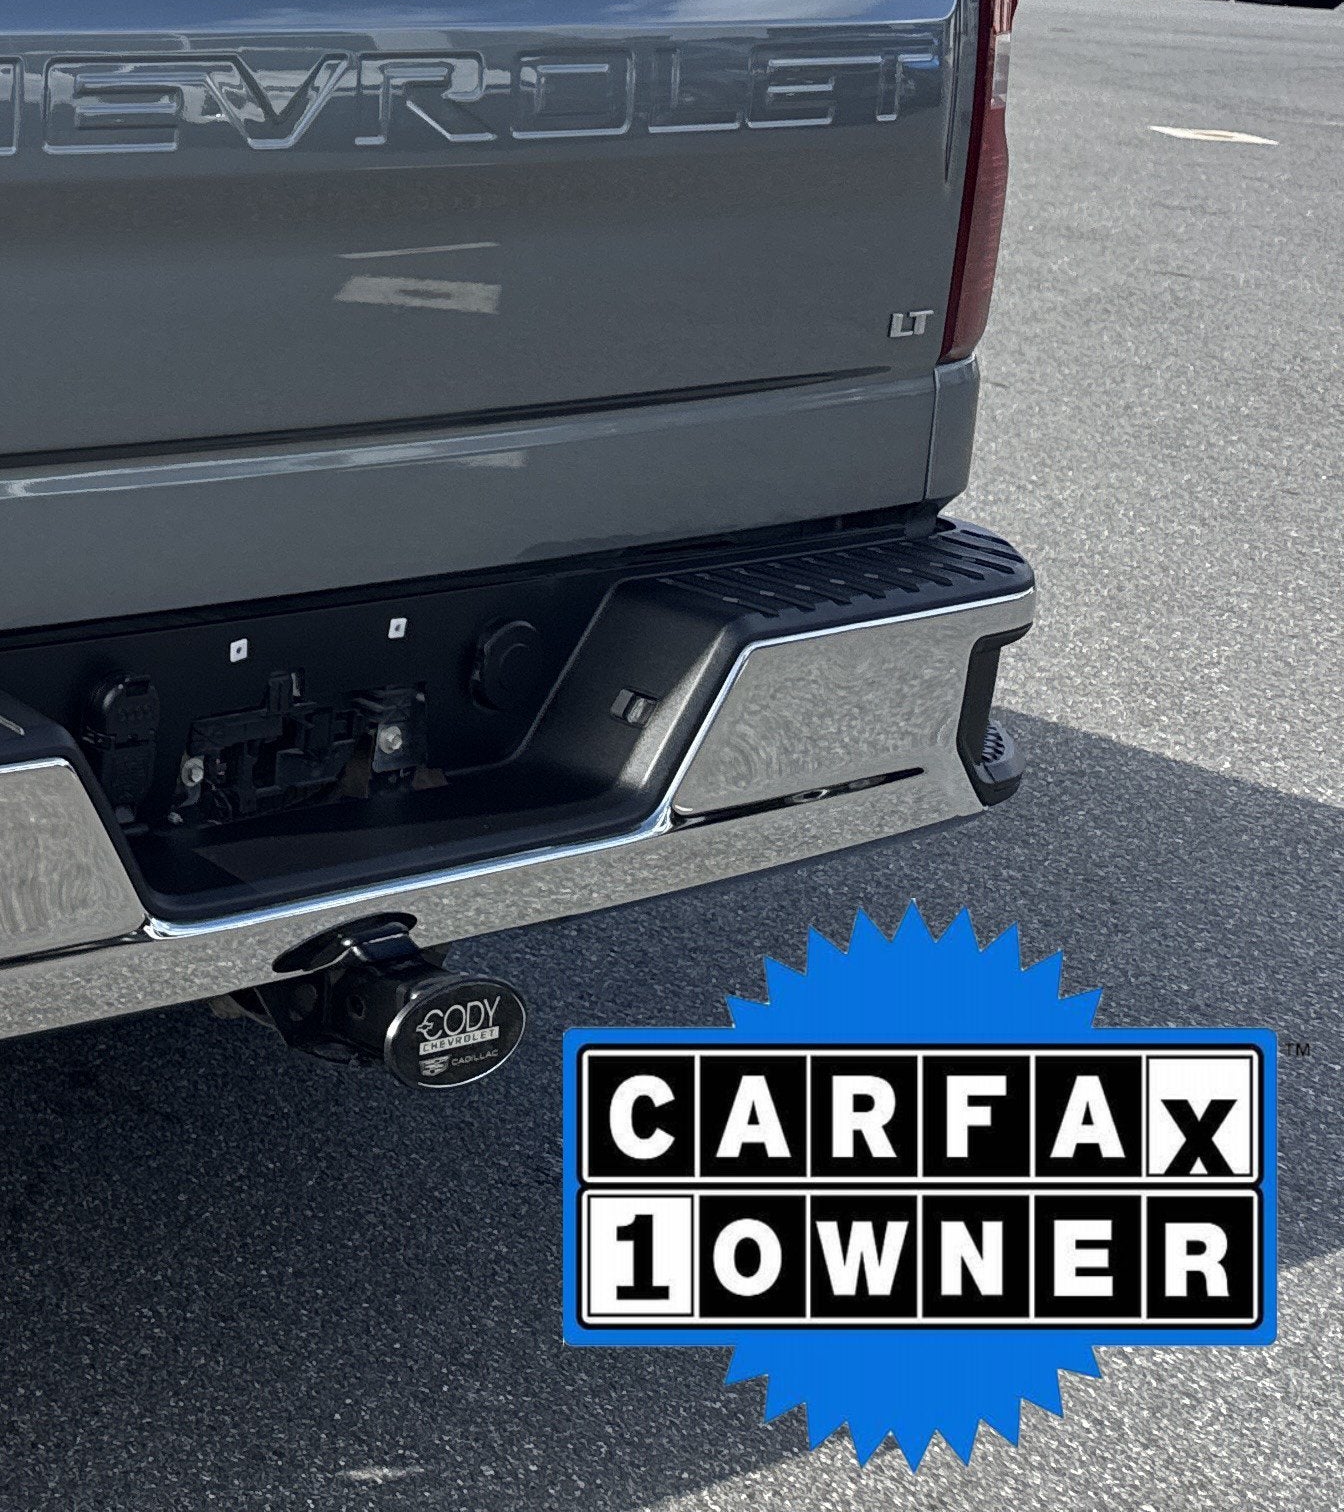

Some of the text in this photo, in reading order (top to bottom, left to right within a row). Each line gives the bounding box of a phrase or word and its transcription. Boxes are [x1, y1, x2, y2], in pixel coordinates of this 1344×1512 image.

[887, 310, 934, 338] LT
[418, 995, 501, 1041] CODY
[422, 1028, 497, 1053] CHEVROLET
